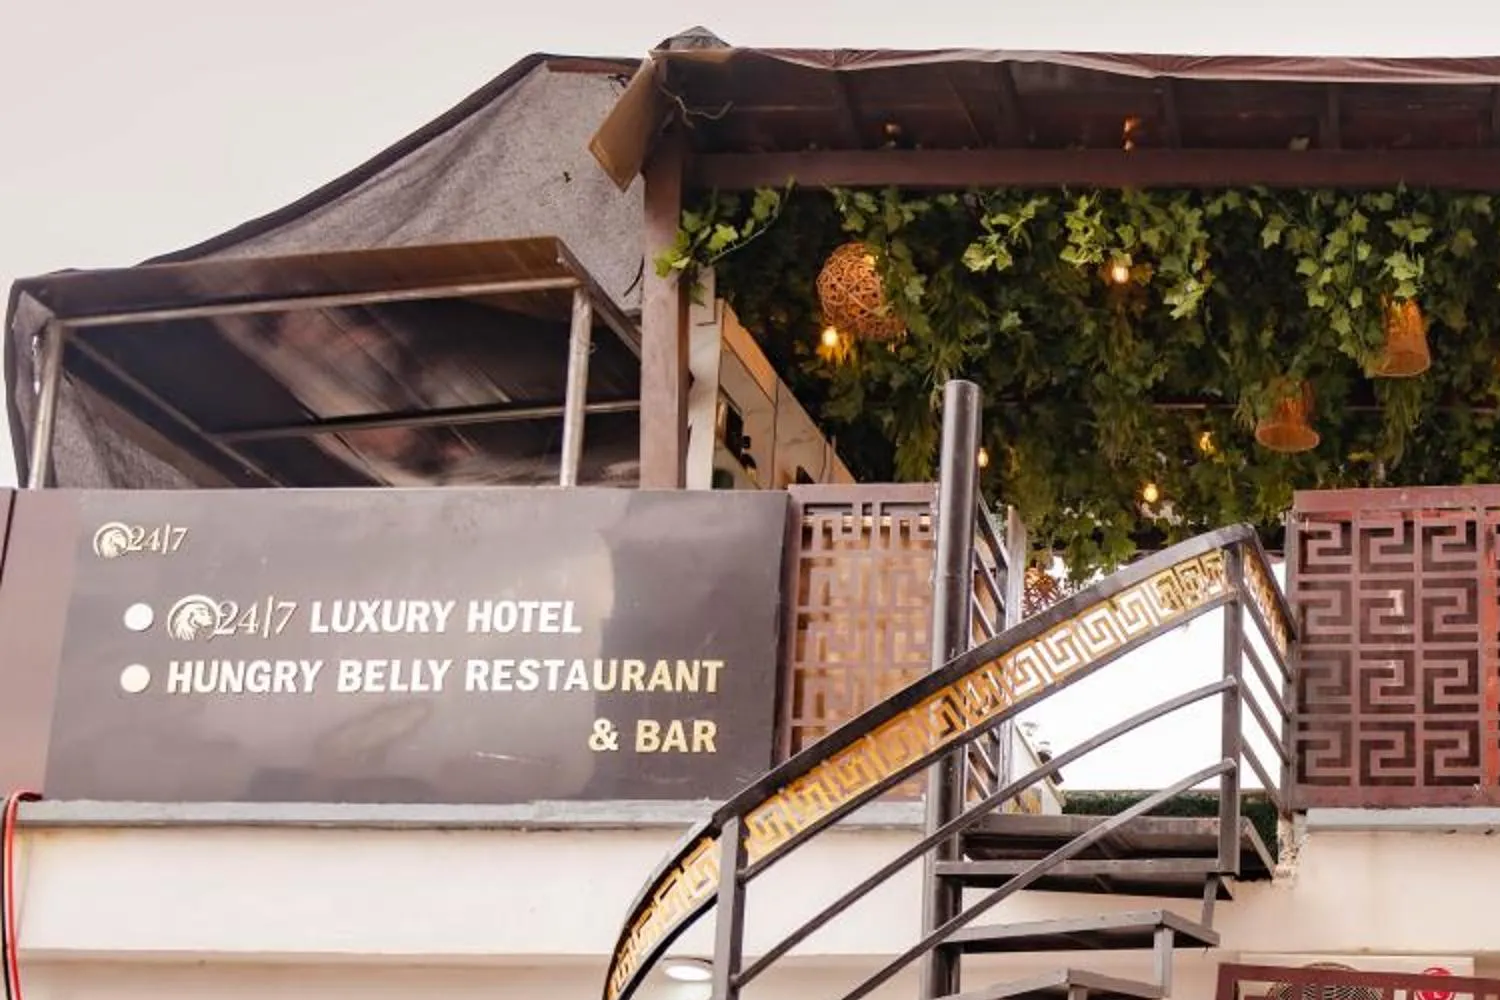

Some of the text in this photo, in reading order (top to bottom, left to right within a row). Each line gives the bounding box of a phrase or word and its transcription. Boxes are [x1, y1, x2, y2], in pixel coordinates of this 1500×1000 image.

[309, 599, 455, 634] LUXURY
[467, 600, 583, 633] HOTEL
[166, 658, 725, 694] HUNGRY BELLY RESTAURANT
[588, 717, 718, 753] & BAR
